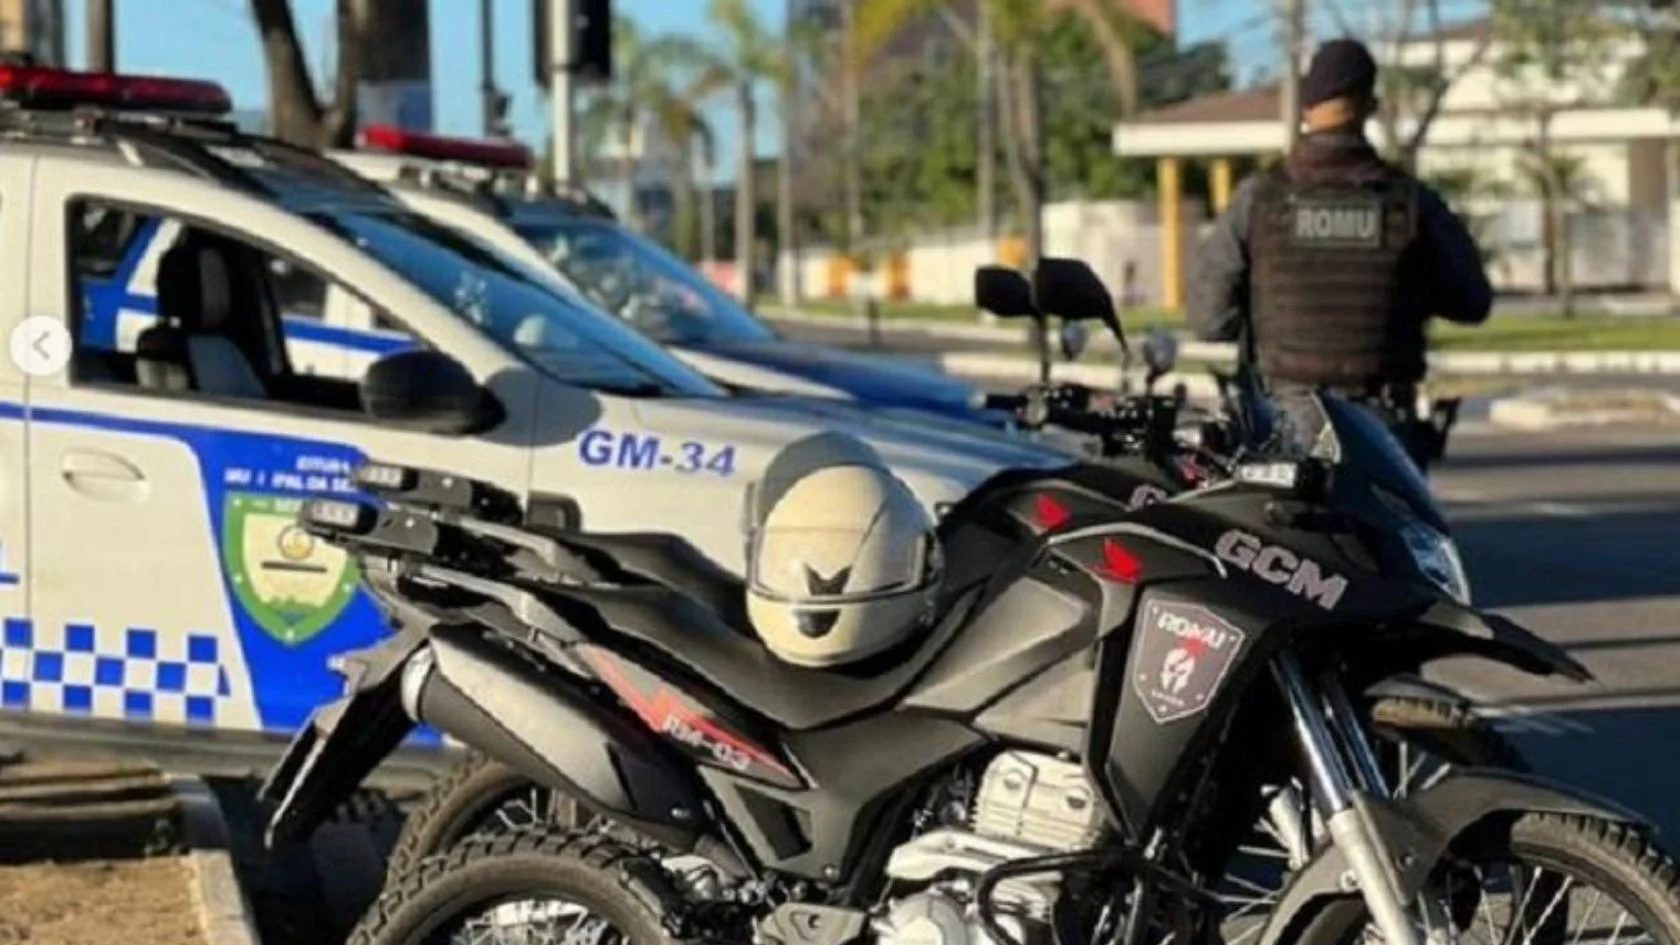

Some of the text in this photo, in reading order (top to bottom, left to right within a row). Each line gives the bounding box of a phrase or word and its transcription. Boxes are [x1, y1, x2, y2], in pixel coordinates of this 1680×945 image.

[1296, 208, 1378, 239] ROMU
[579, 429, 736, 477] GM-34
[1215, 528, 1349, 611] GCM
